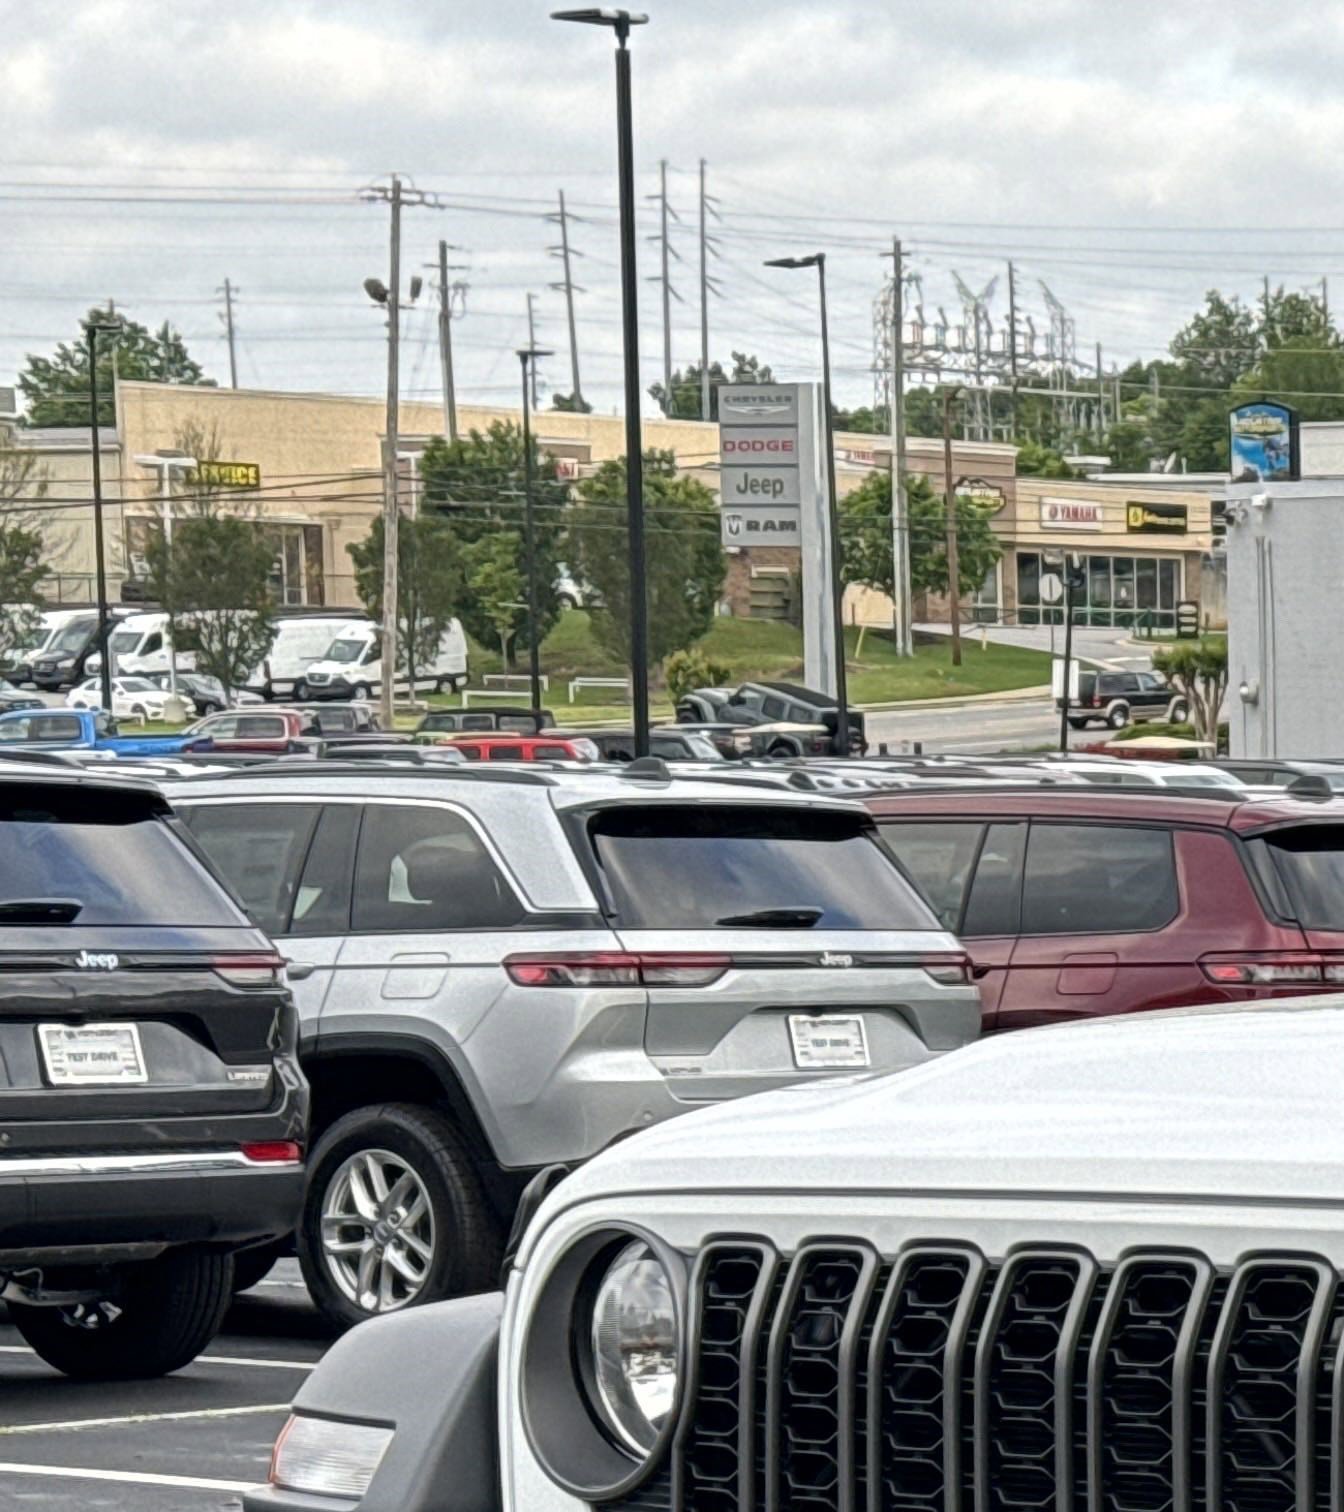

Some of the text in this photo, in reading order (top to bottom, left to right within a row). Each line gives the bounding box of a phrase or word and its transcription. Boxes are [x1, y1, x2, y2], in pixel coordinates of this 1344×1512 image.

[722, 440, 794, 451] DODGE
[735, 472, 785, 499] Jeep
[1059, 506, 1098, 523] YAMAHA
[746, 520, 797, 532] RAM
[75, 950, 118, 970] Jeep
[820, 952, 853, 968] Jeep
